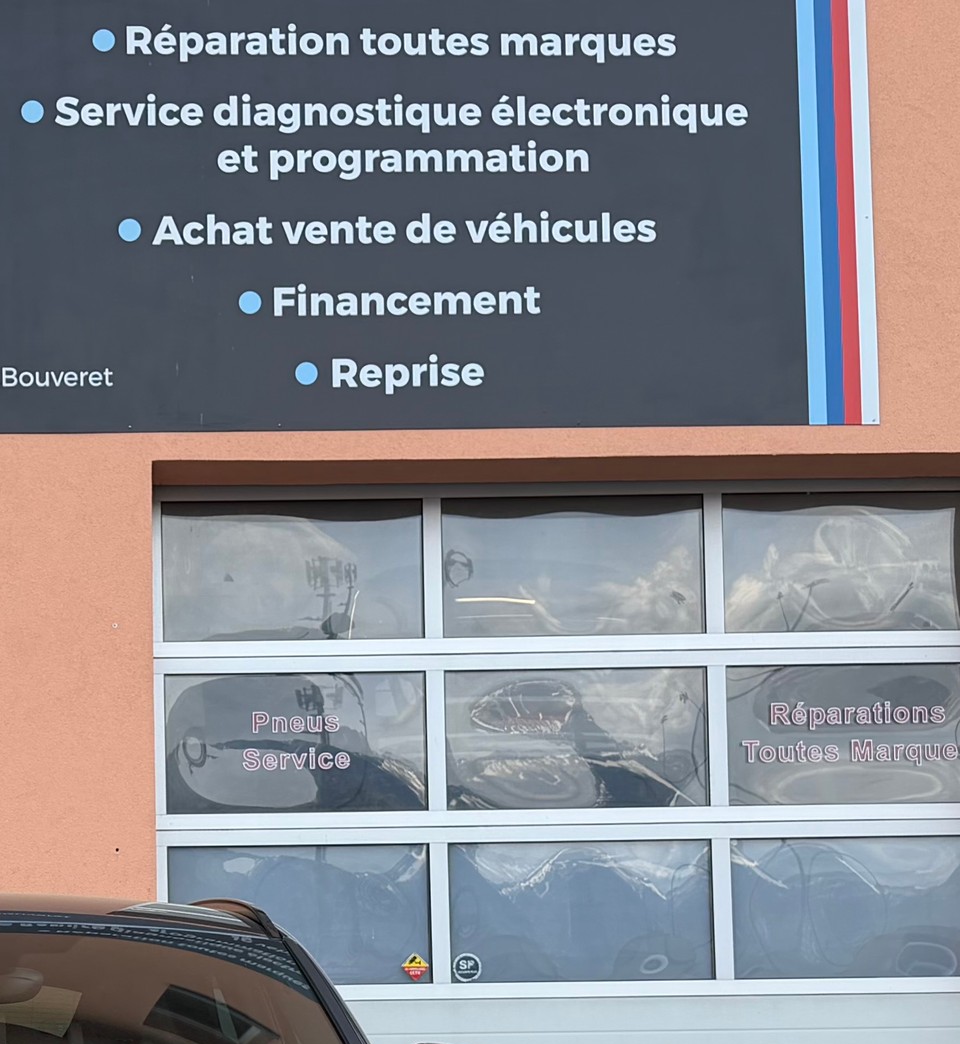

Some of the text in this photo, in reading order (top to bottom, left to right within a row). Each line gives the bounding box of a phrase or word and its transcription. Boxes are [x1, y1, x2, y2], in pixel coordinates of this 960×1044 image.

[126, 24, 677, 63] Réparation toutes marques
[54, 93, 749, 134] Service diagnostique électronique
[217, 142, 590, 181] et programmation
[152, 211, 657, 246] Achat vente de véhicules
[273, 283, 541, 317] Financement
[331, 354, 485, 395] Reprise
[252, 711, 340, 733] Pneus
[770, 702, 945, 730] Réparations
[242, 747, 351, 771] Service
[742, 740, 839, 763] Toutes
